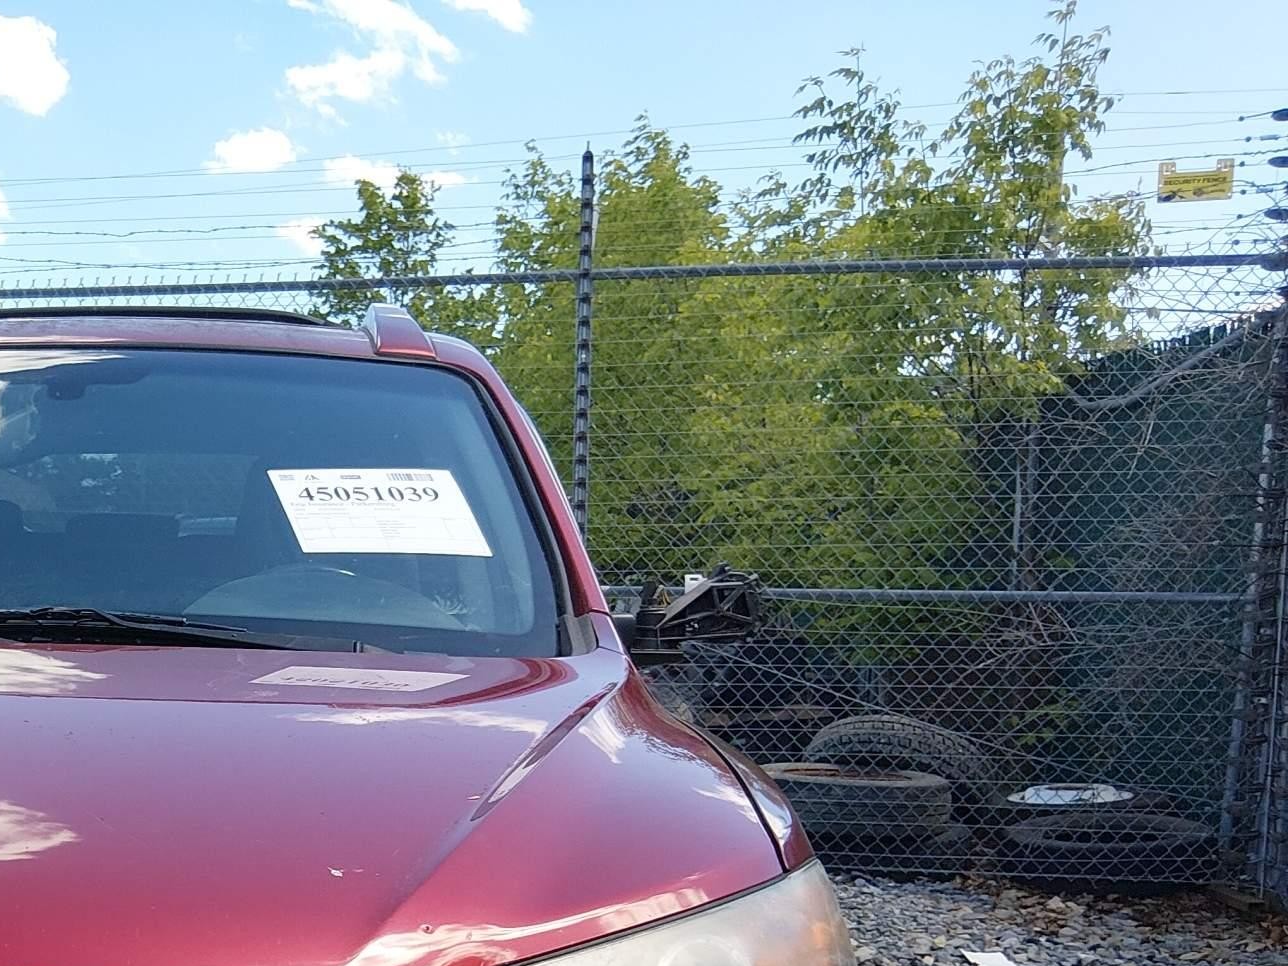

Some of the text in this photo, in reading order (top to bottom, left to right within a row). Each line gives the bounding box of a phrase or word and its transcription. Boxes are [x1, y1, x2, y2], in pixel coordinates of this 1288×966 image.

[1163, 176, 1227, 186] SECURITY FENCE
[298, 486, 439, 501] 45051039
